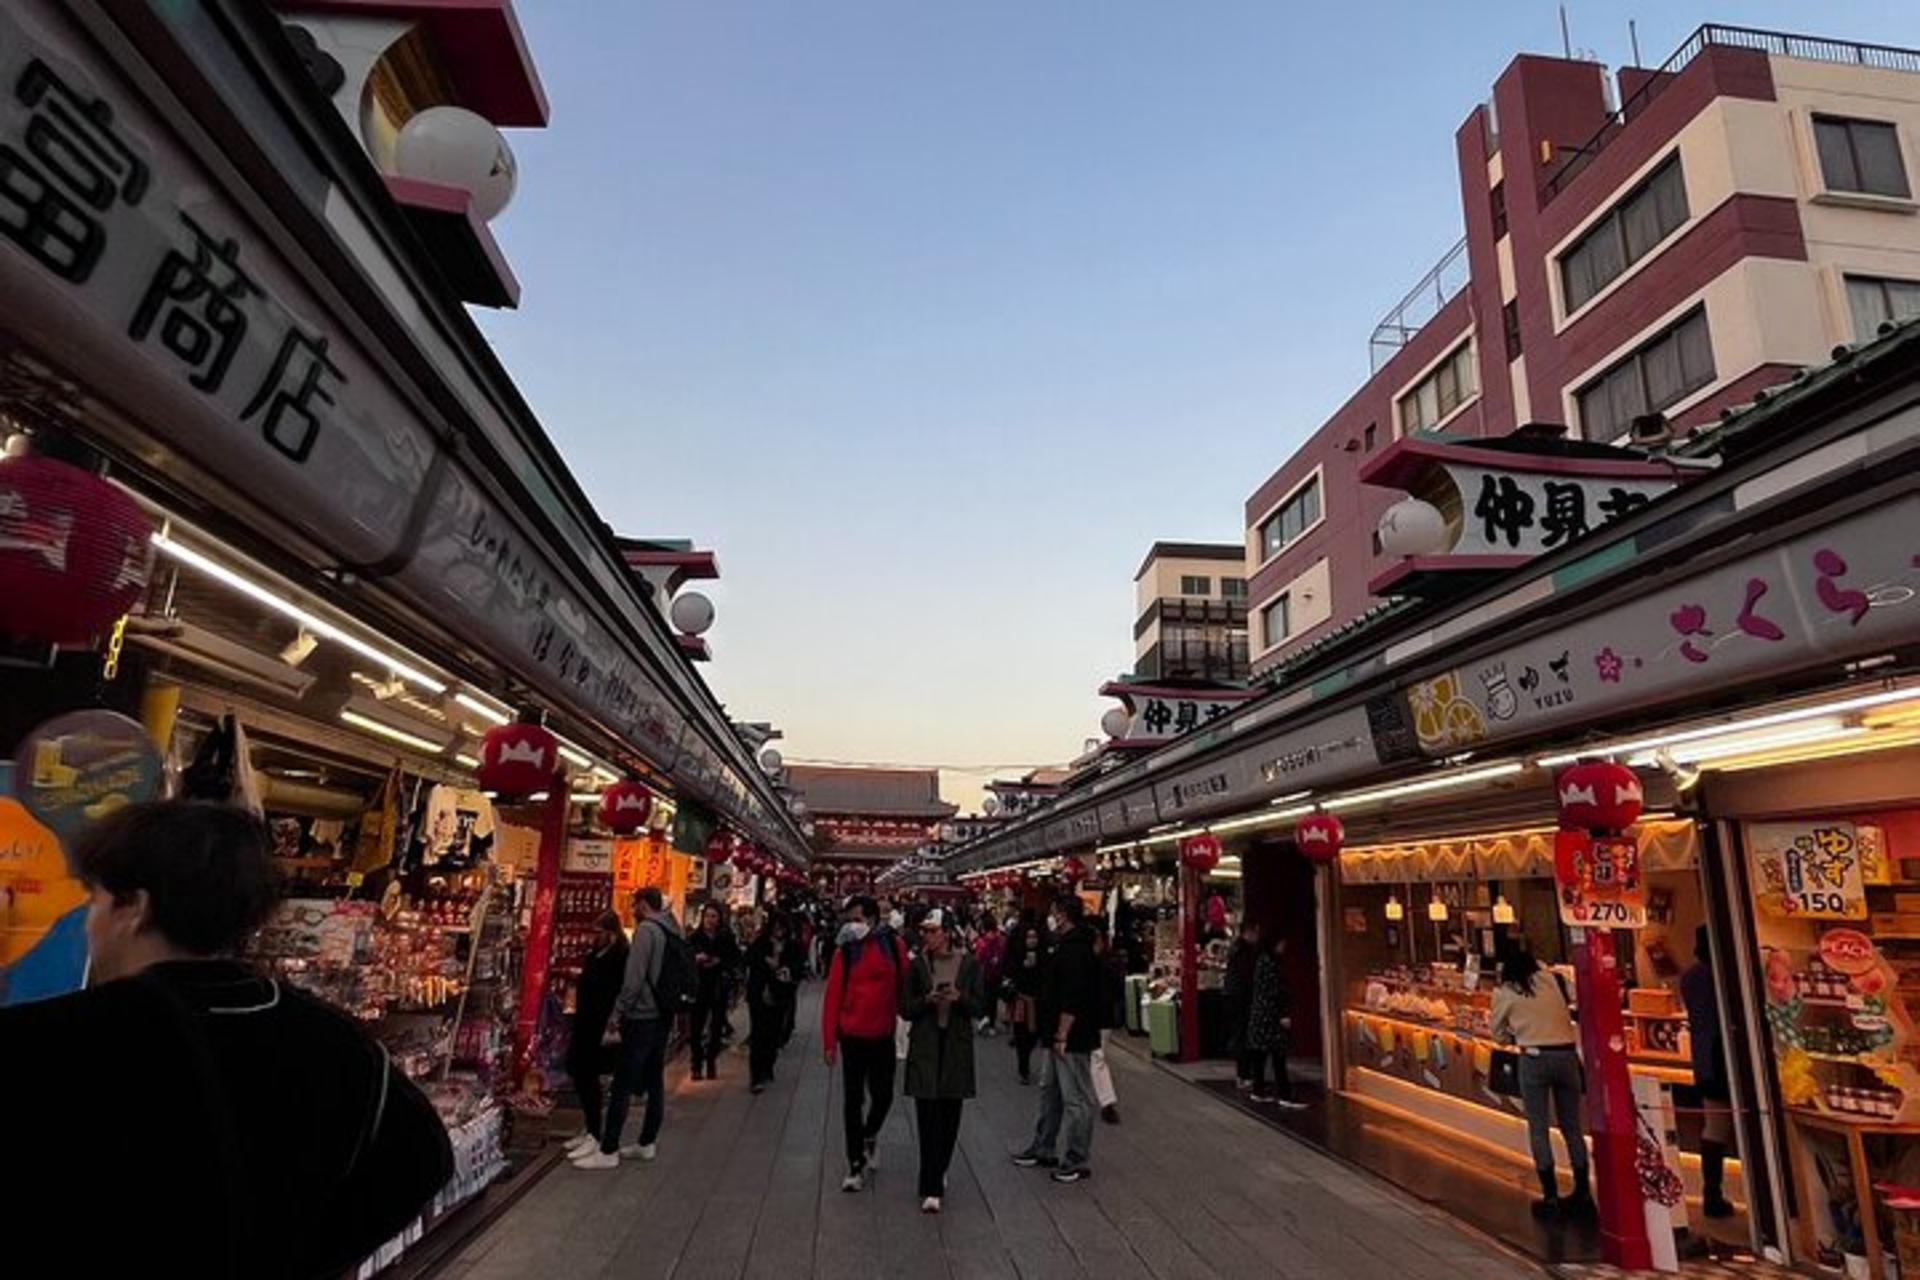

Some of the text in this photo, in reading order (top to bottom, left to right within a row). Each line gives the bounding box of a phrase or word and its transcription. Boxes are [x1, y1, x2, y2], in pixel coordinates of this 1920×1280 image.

[1670, 548, 1870, 663] さくら
[1518, 649, 1570, 694] ゆず
[1533, 689, 1575, 710] YUZU
[1813, 827, 1854, 889] ゆず
